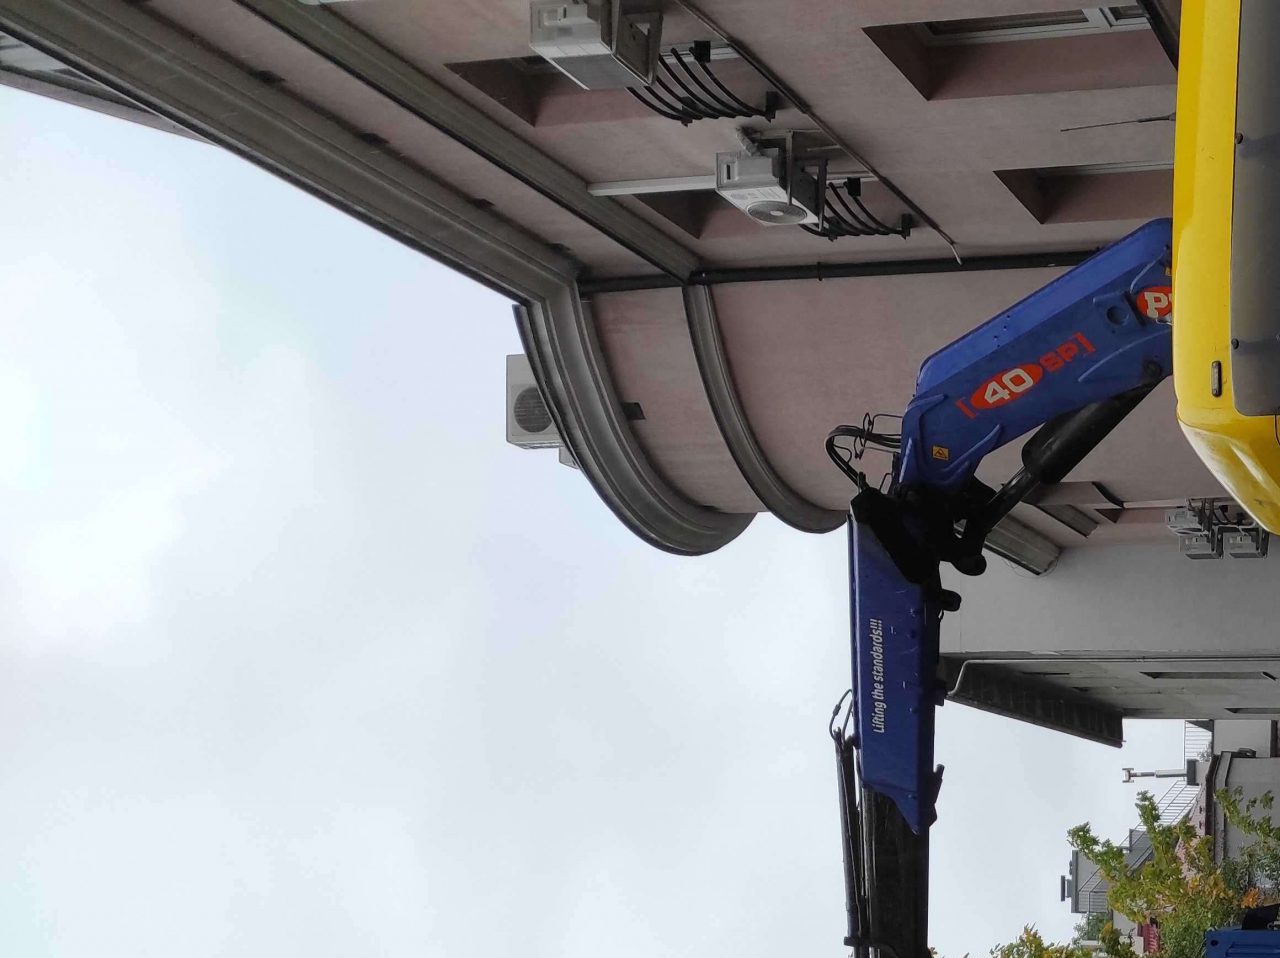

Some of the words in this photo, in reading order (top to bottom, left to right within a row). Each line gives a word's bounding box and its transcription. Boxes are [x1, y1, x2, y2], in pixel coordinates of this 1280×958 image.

[1144, 290, 1172, 319] P
[984, 368, 1034, 404] 40
[869, 618, 884, 681] standards!!!
[871, 681, 884, 700] the
[871, 702, 887, 733] Lifting
